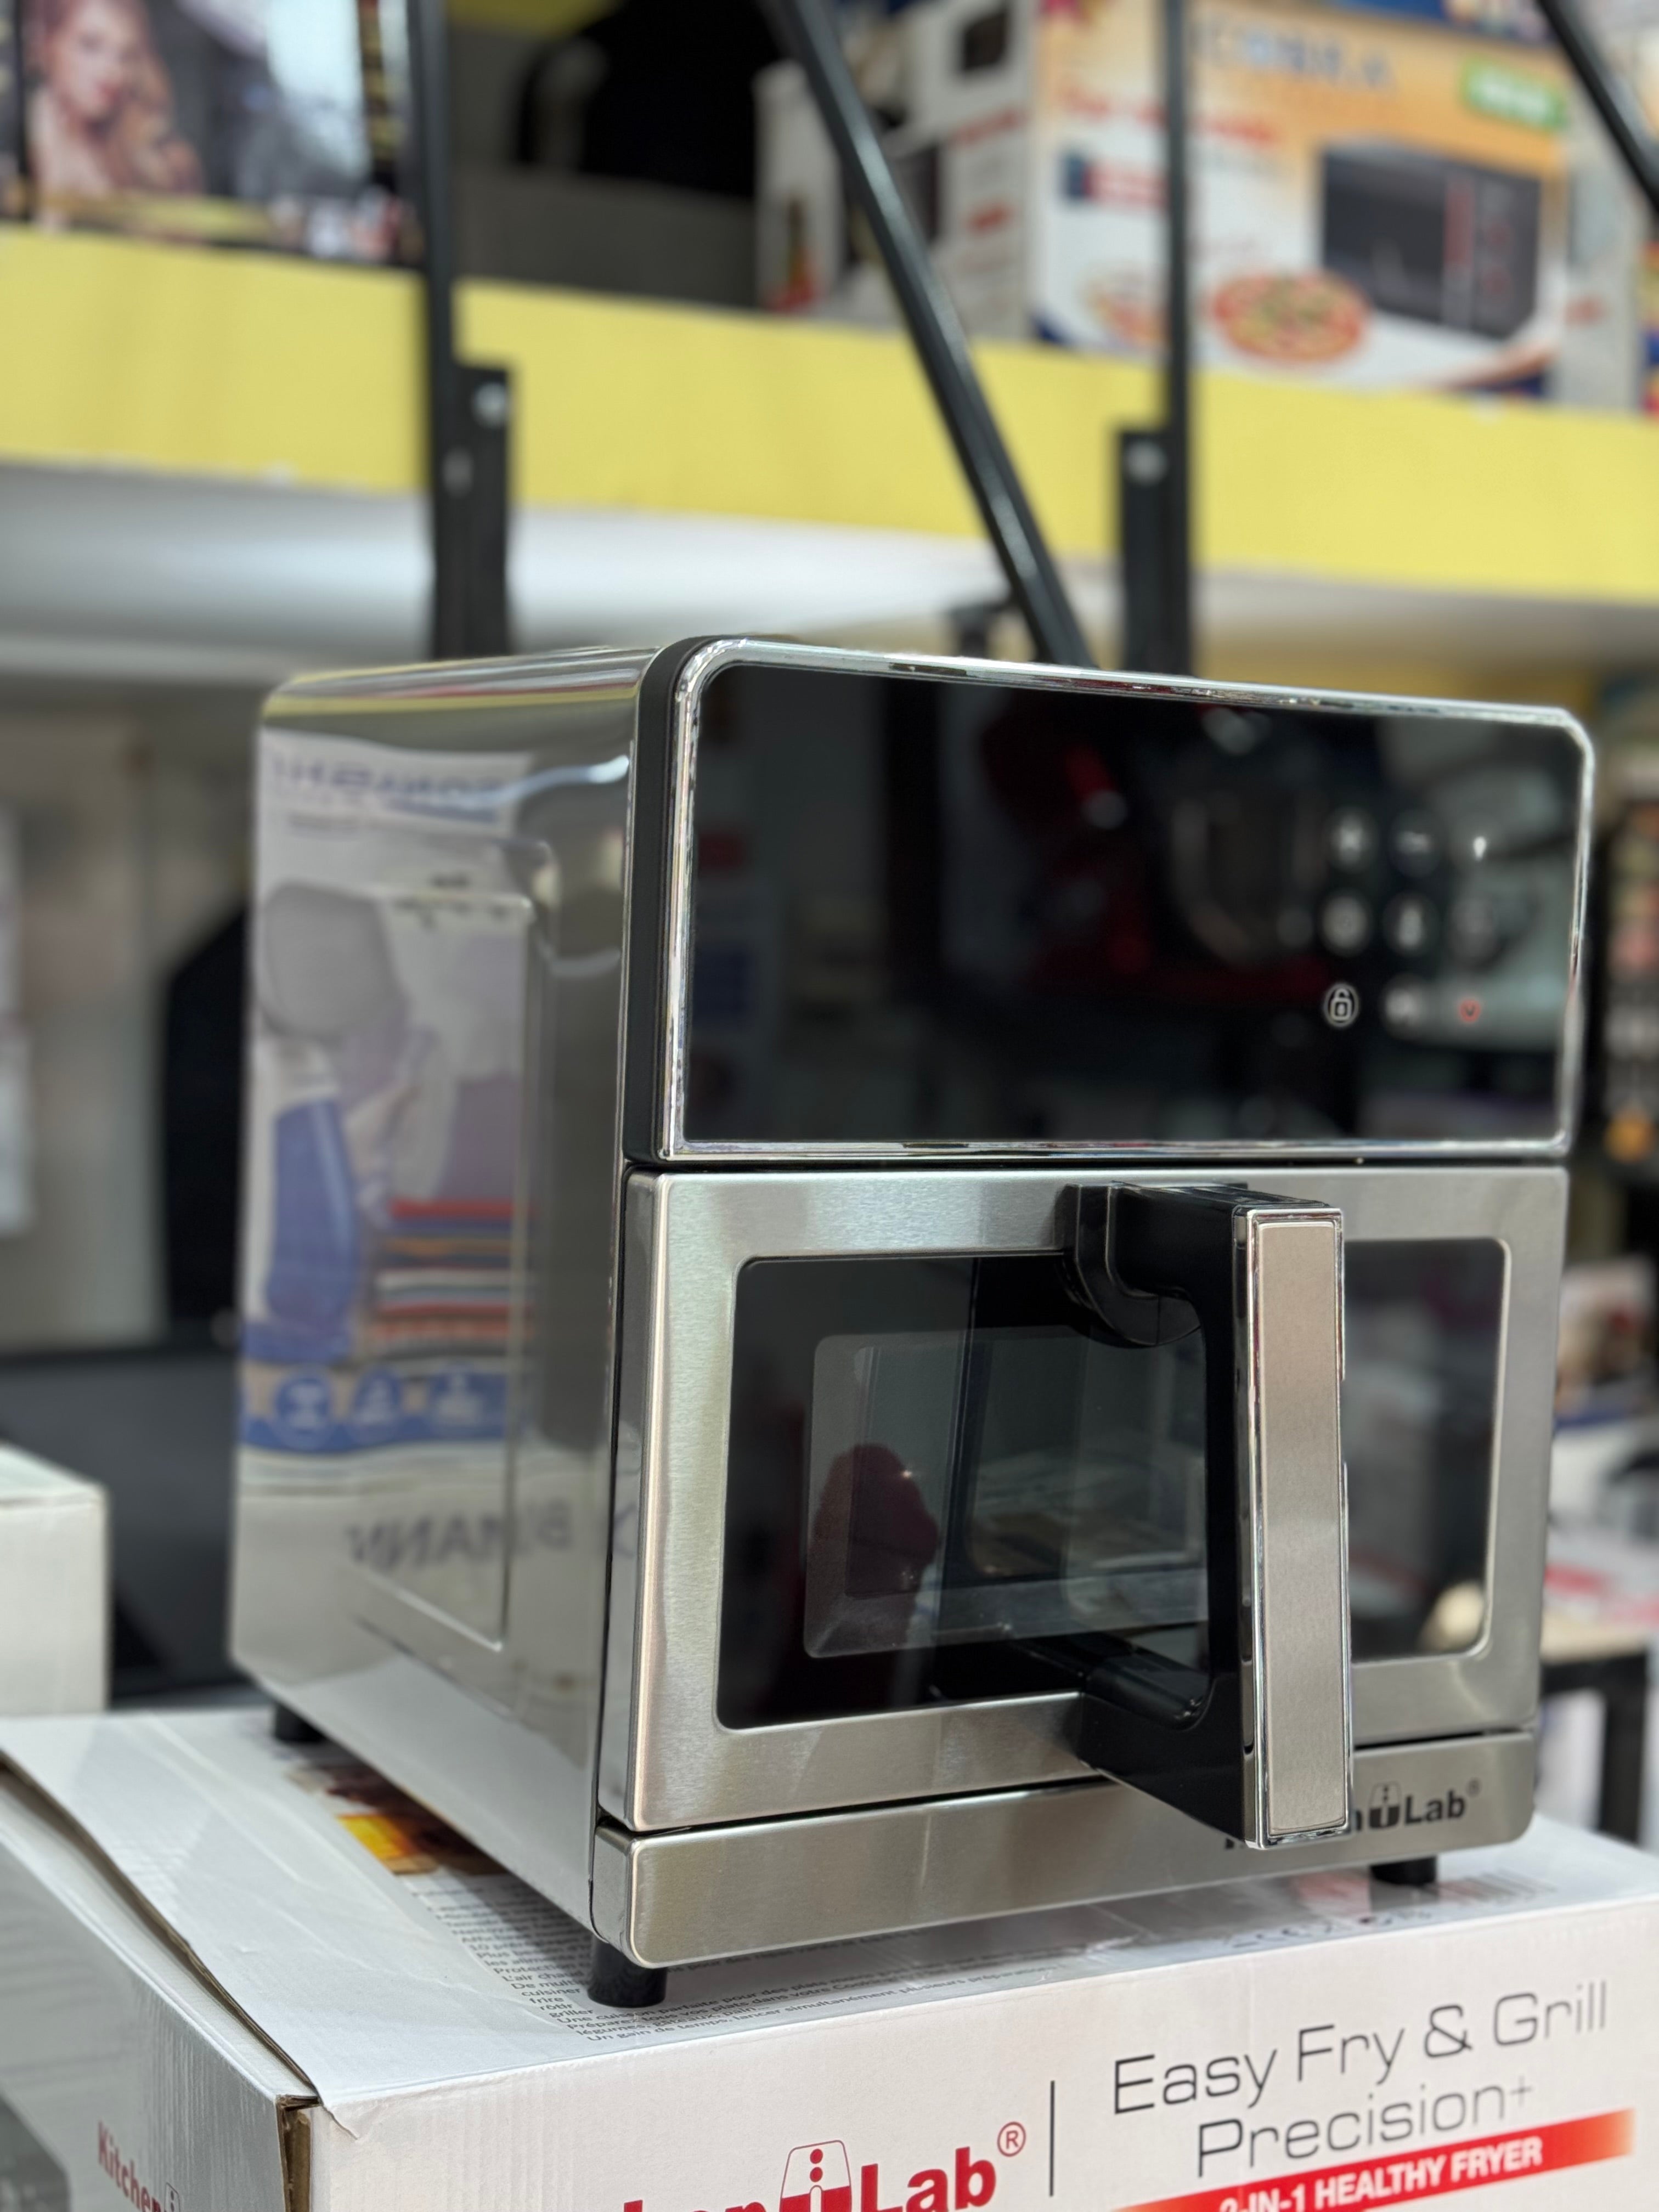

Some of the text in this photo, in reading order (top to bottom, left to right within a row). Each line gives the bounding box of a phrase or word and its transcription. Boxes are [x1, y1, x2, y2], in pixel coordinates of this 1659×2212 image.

[521, 1988, 581, 1996] cuisiner
[528, 1996, 565, 2004] frire
[539, 2003, 573, 2011] rôtir
[566, 2018, 640, 2029] Préparez
[641, 2013, 677, 2022] tous
[712, 2001, 749, 2012] plats
[752, 1994, 789, 2004] dans
[789, 1987, 831, 1998] votre
[596, 2010, 655, 2020] cuisson
[658, 2000, 718, 2014] parfaite
[722, 1993, 757, 2003] pour
[760, 1987, 789, 1995] des
[790, 1981, 827, 1991] plats
[617, 2029, 651, 2039] gain
[733, 2008, 781, 2020] lancer
[785, 1990, 898, 2011] simultanément
[899, 1978, 966, 1994] plusieurs
[549, 2009, 594, 2018] griller
[1114, 1979, 1607, 2114] Easy Fry & Grill
[1314, 2154, 1447, 2210] HEALTHY
[1450, 2135, 1543, 2183] FRYER
